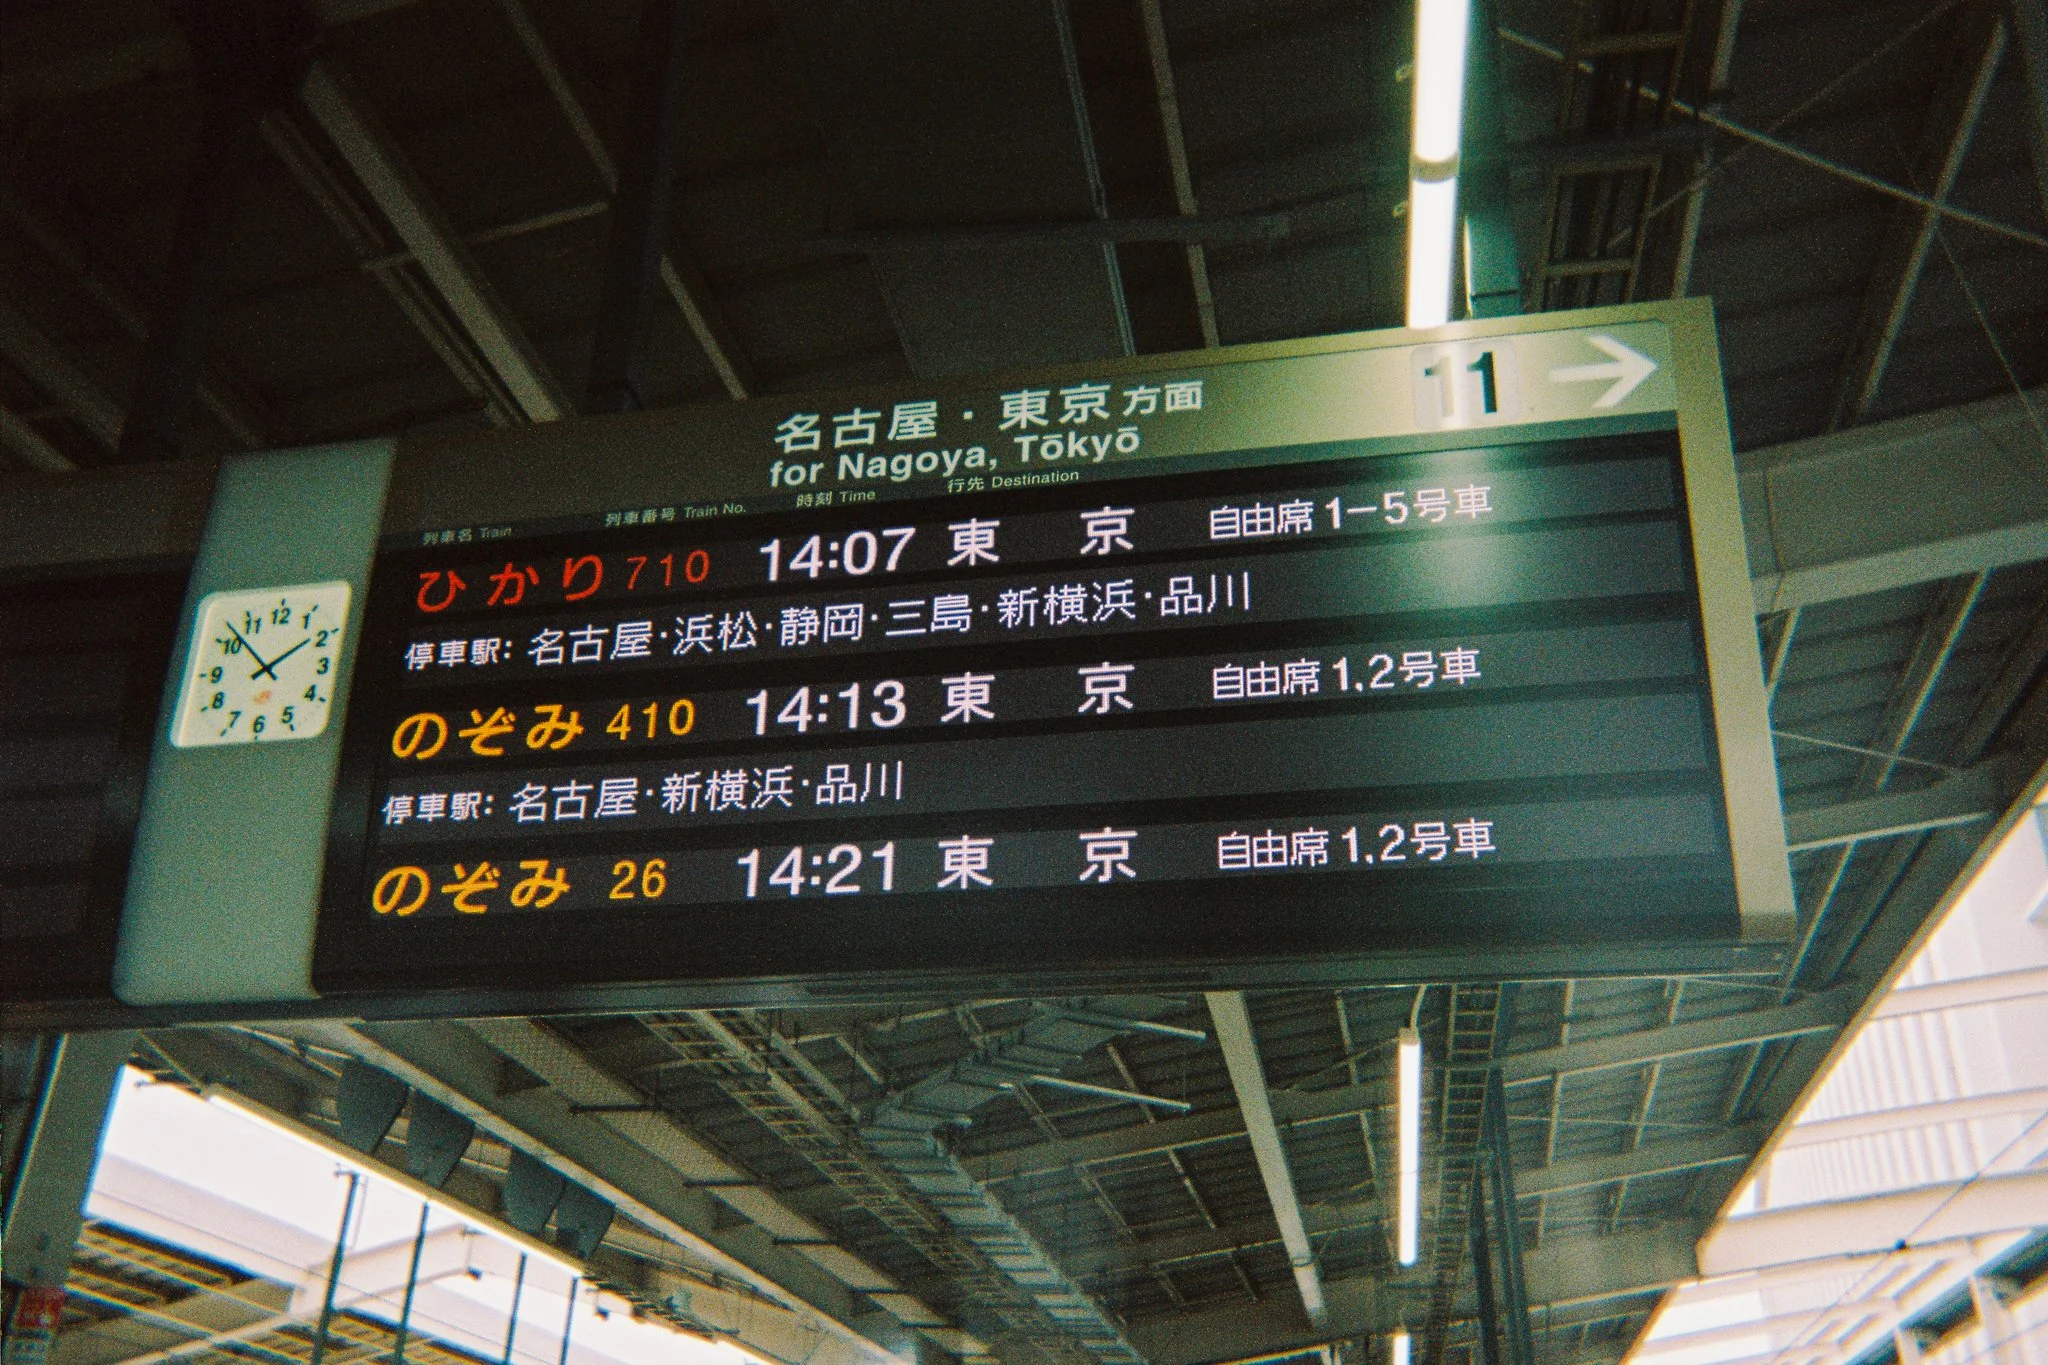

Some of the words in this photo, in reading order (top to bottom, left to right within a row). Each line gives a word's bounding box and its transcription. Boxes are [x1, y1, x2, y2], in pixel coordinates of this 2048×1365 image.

[770, 460, 825, 488] for
[837, 444, 998, 480] Nagoya,
[1013, 426, 1141, 463] Tōkyō
[947, 477, 986, 494] 行先
[990, 469, 1081, 489] Destination
[839, 490, 876, 503] Time
[684, 506, 718, 518] Train
[722, 503, 746, 515] No.
[479, 526, 512, 539] Train
[417, 555, 603, 612] ひかり
[627, 549, 710, 590] 710
[759, 526, 916, 582] 14:07
[271, 608, 292, 625] 12
[303, 613, 311, 630] 1
[245, 617, 262, 635] 11
[223, 636, 242, 655] 10
[315, 630, 329, 648] 2
[210, 666, 224, 684] 9
[316, 657, 330, 675] 3
[211, 692, 225, 710] 8
[303, 684, 317, 702] 4
[228, 710, 242, 728] 7
[253, 714, 267, 733] 6
[281, 705, 295, 724] 5
[392, 704, 585, 760] のぞみ
[606, 698, 695, 741] 410
[746, 679, 907, 736] 14:13
[372, 859, 571, 916] のぞみ
[609, 858, 667, 900] 26
[737, 841, 895, 898] 14:21
